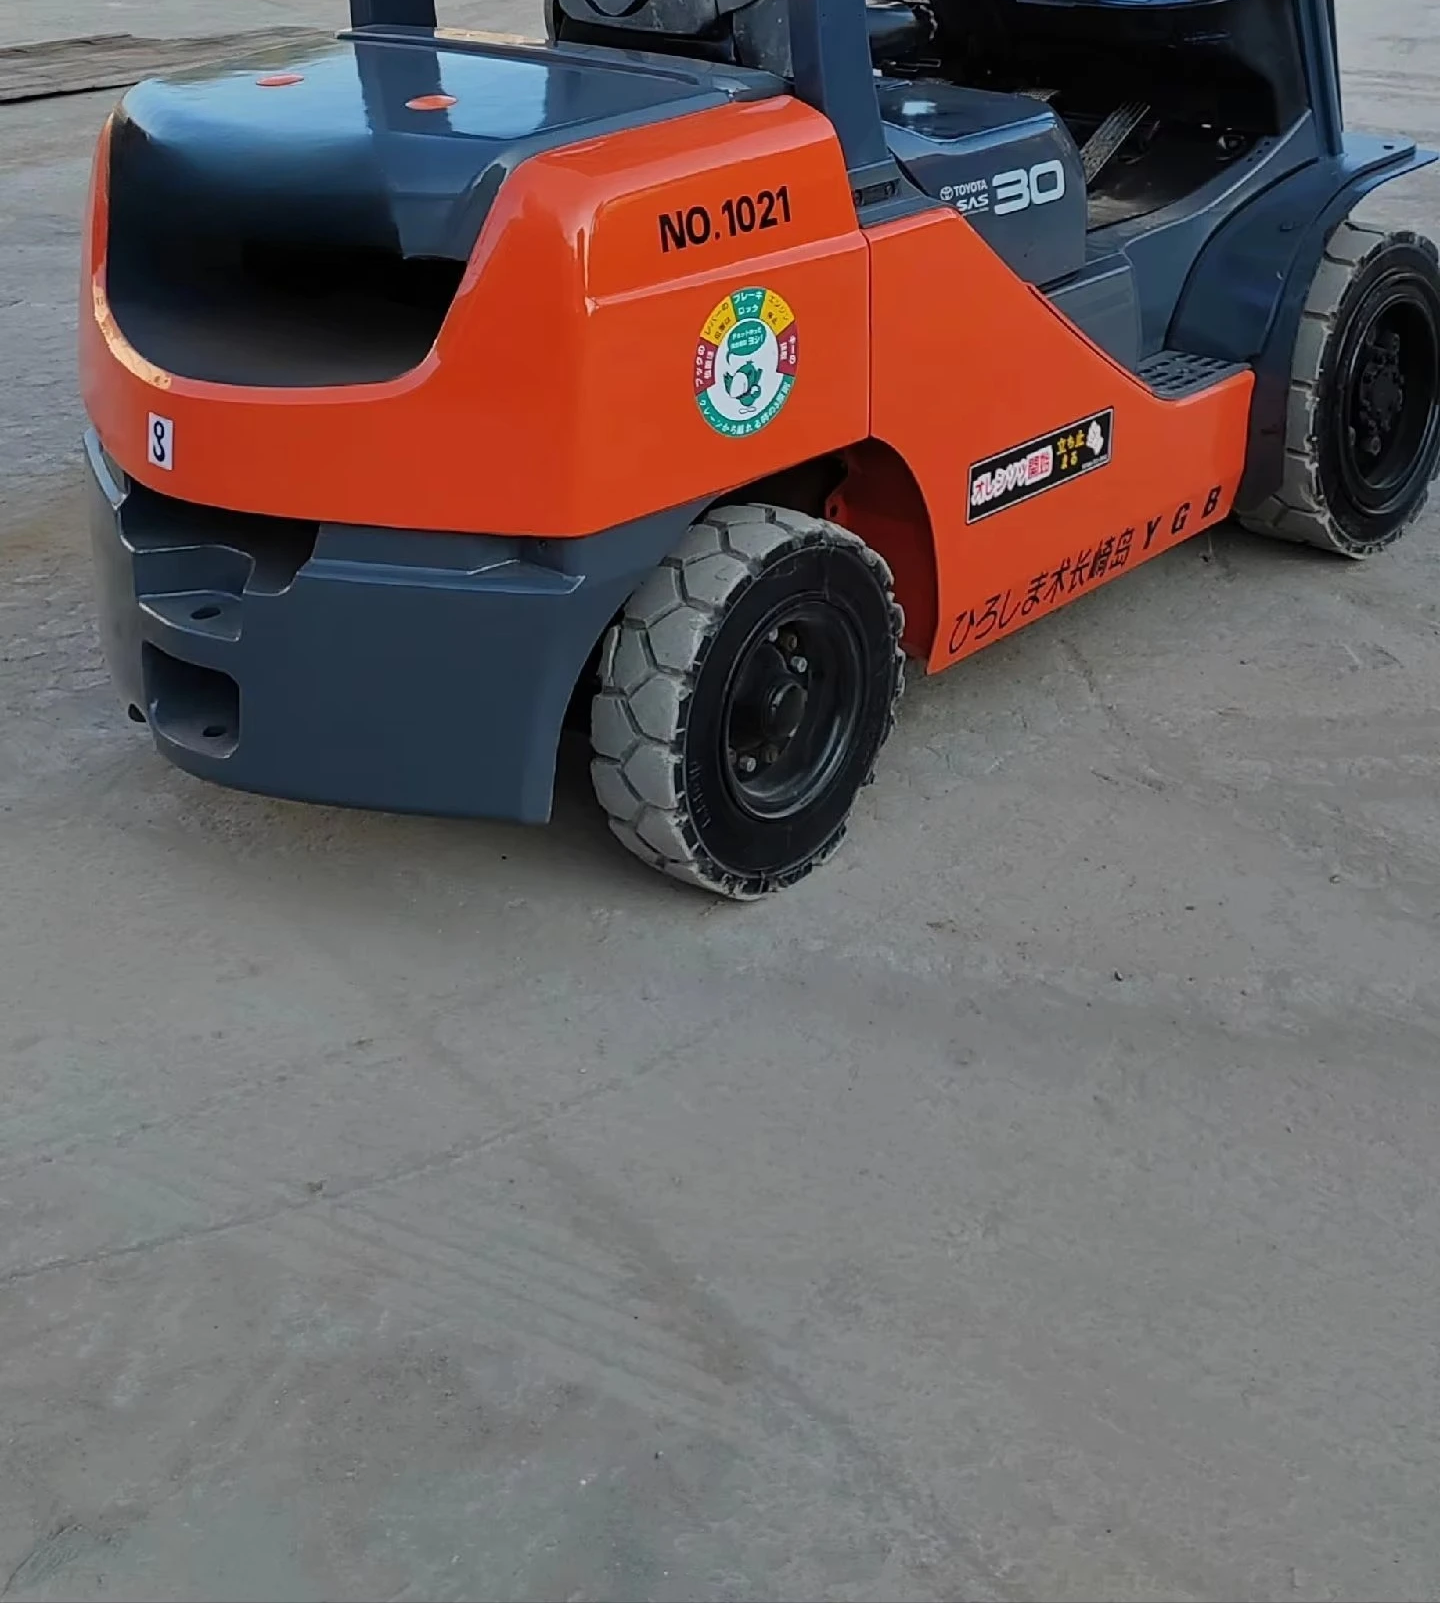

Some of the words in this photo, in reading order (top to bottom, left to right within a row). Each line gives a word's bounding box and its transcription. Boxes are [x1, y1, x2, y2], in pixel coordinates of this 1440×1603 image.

[953, 179, 988, 197] TOYOTA
[992, 160, 1065, 215] 30
[956, 193, 989, 212] SAS
